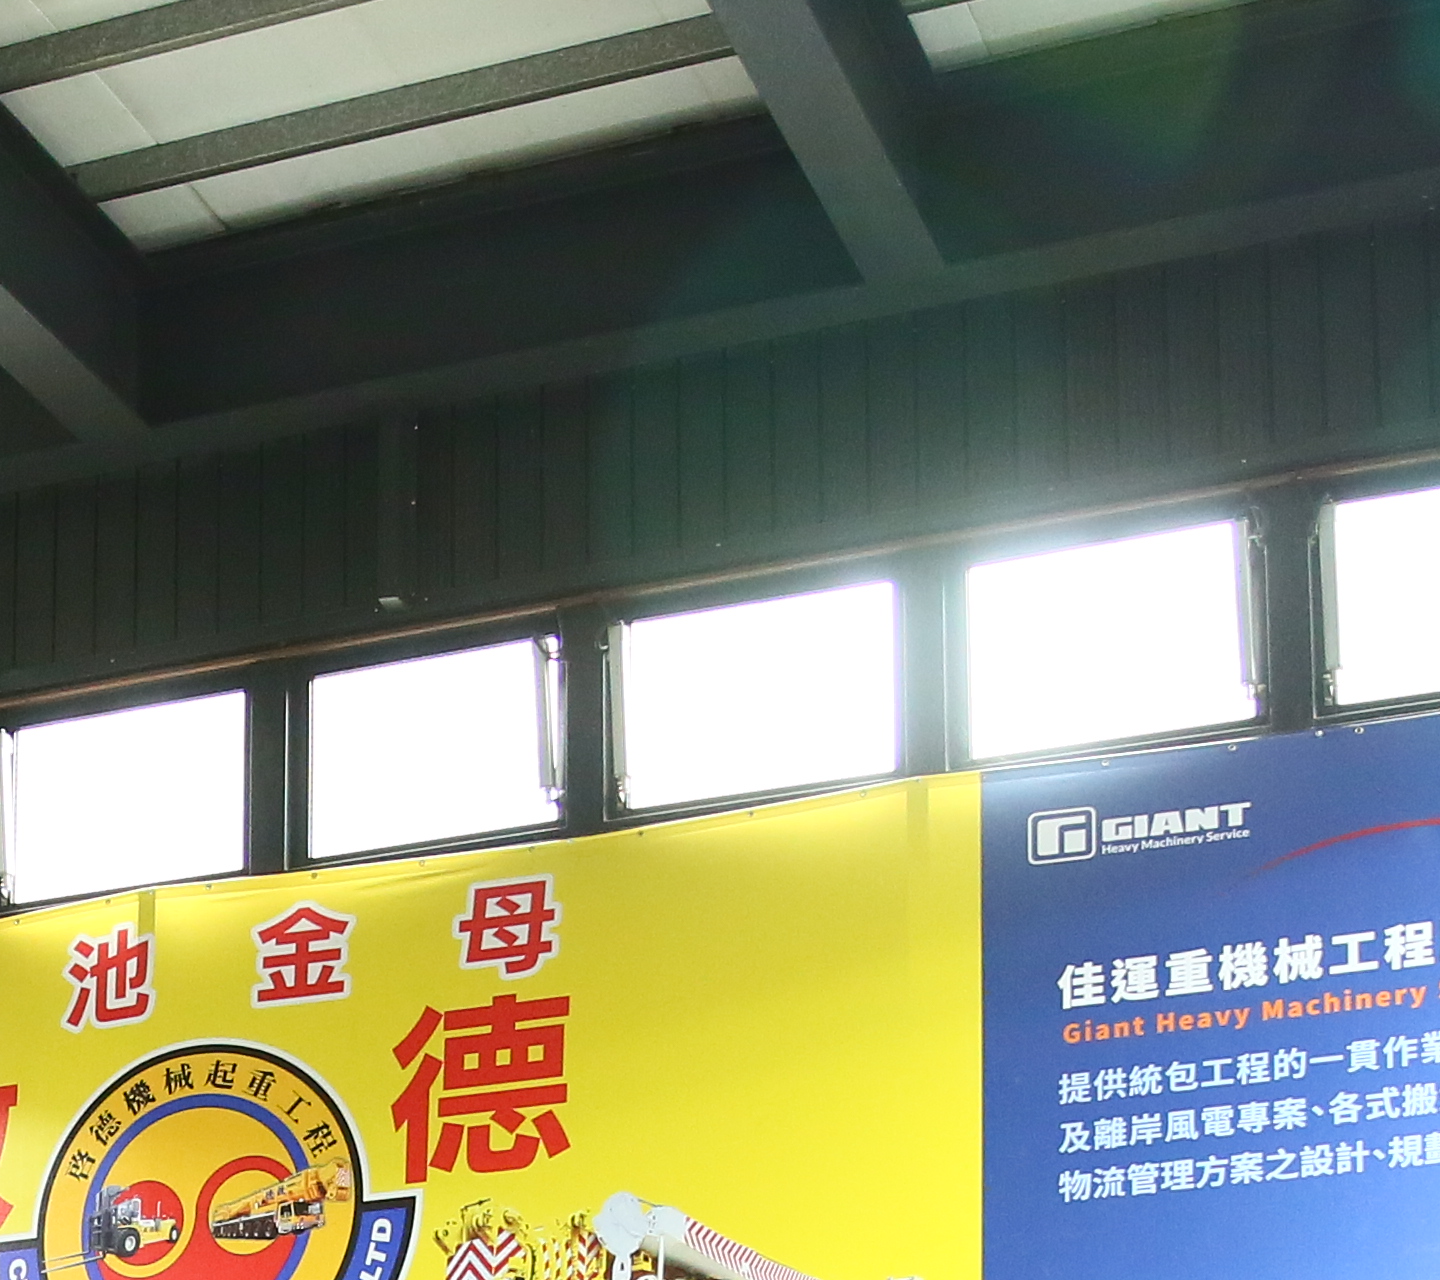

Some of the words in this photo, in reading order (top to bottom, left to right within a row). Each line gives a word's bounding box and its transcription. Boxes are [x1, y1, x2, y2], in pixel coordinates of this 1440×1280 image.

[1101, 801, 1253, 843] GIANT
[1101, 843, 1140, 855] Heavy
[1140, 833, 1205, 851] Machinery
[1205, 827, 1251, 843] Service
[1062, 1014, 1146, 1045] Giant
[1155, 1004, 1251, 1031] Heavy
[1261, 985, 1428, 1022] Machinery
[391, 993, 573, 1185] 德
